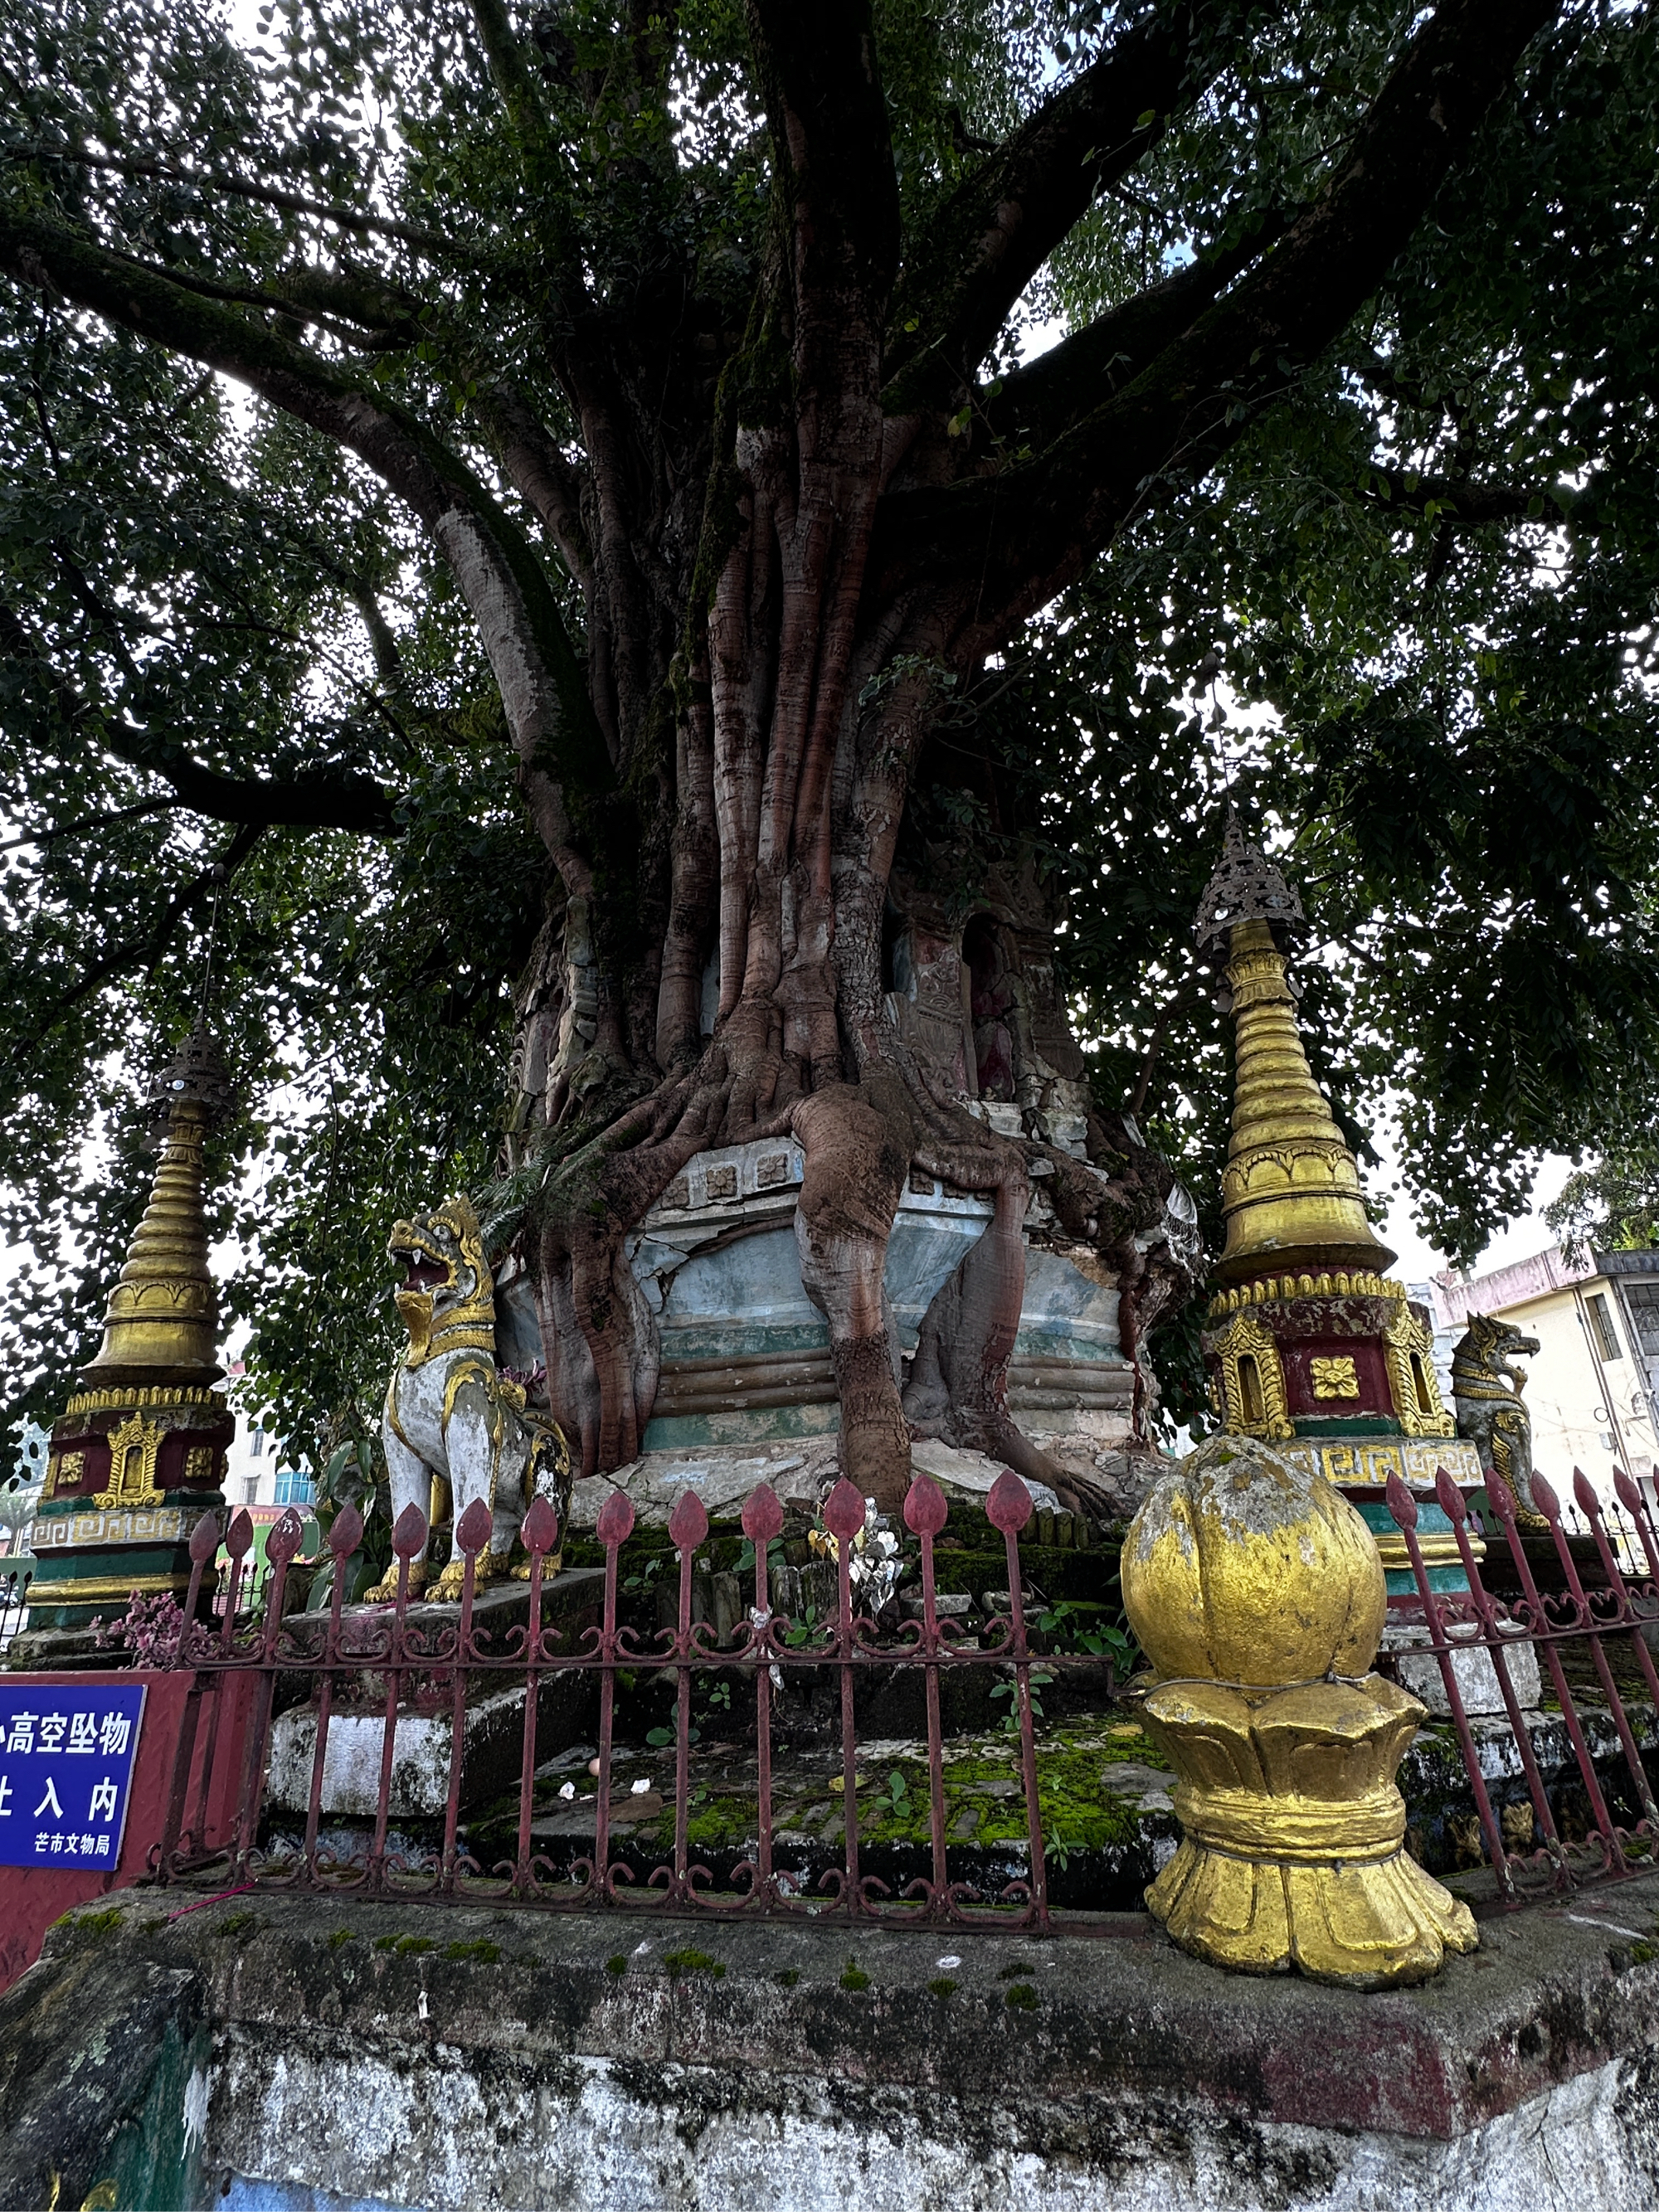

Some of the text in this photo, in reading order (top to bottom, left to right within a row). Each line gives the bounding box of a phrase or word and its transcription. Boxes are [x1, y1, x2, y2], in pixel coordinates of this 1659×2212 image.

[0, 1712, 131, 1755] 高空坠物
[34, 1832, 109, 1855] 芒市文物局
